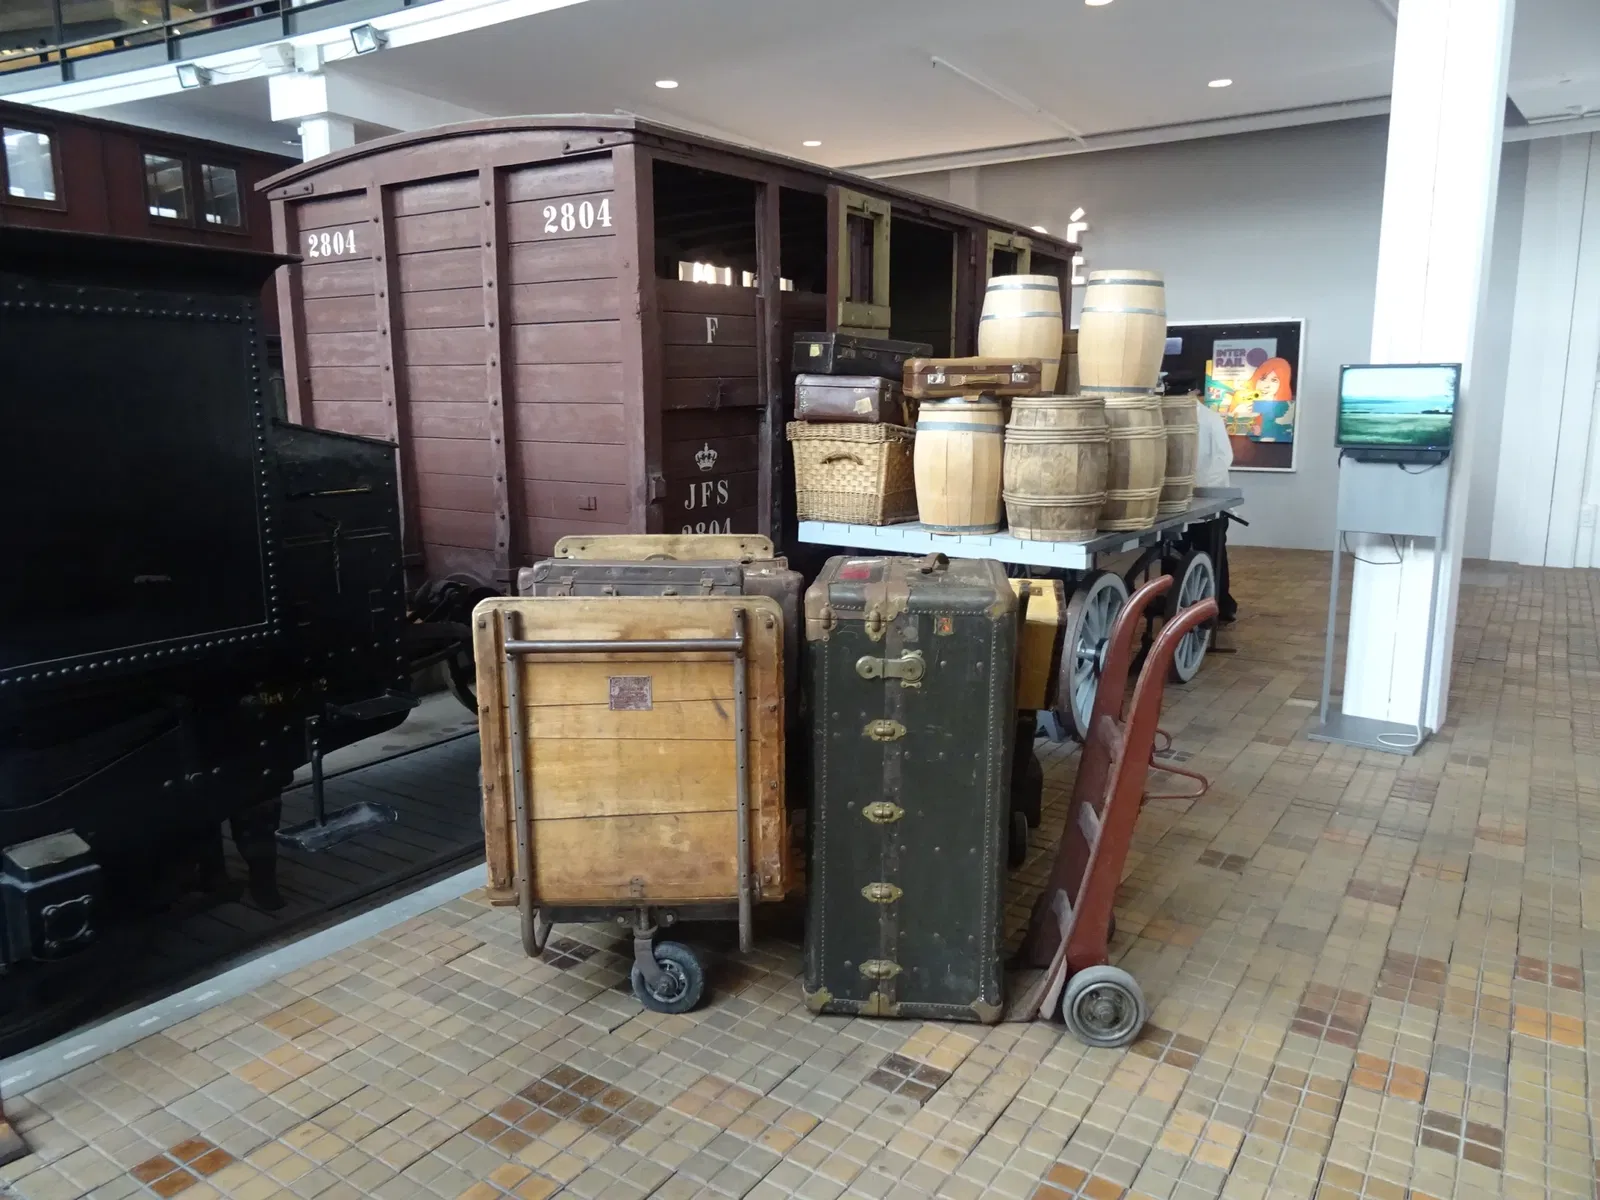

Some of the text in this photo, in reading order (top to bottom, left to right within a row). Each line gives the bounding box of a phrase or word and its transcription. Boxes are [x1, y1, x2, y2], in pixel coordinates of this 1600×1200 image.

[543, 198, 612, 233] 2804
[308, 229, 357, 258] 2804
[706, 316, 719, 343] F
[1215, 348, 1246, 357] INTER
[1215, 357, 1245, 368] RAIL
[684, 479, 729, 510] JFS
